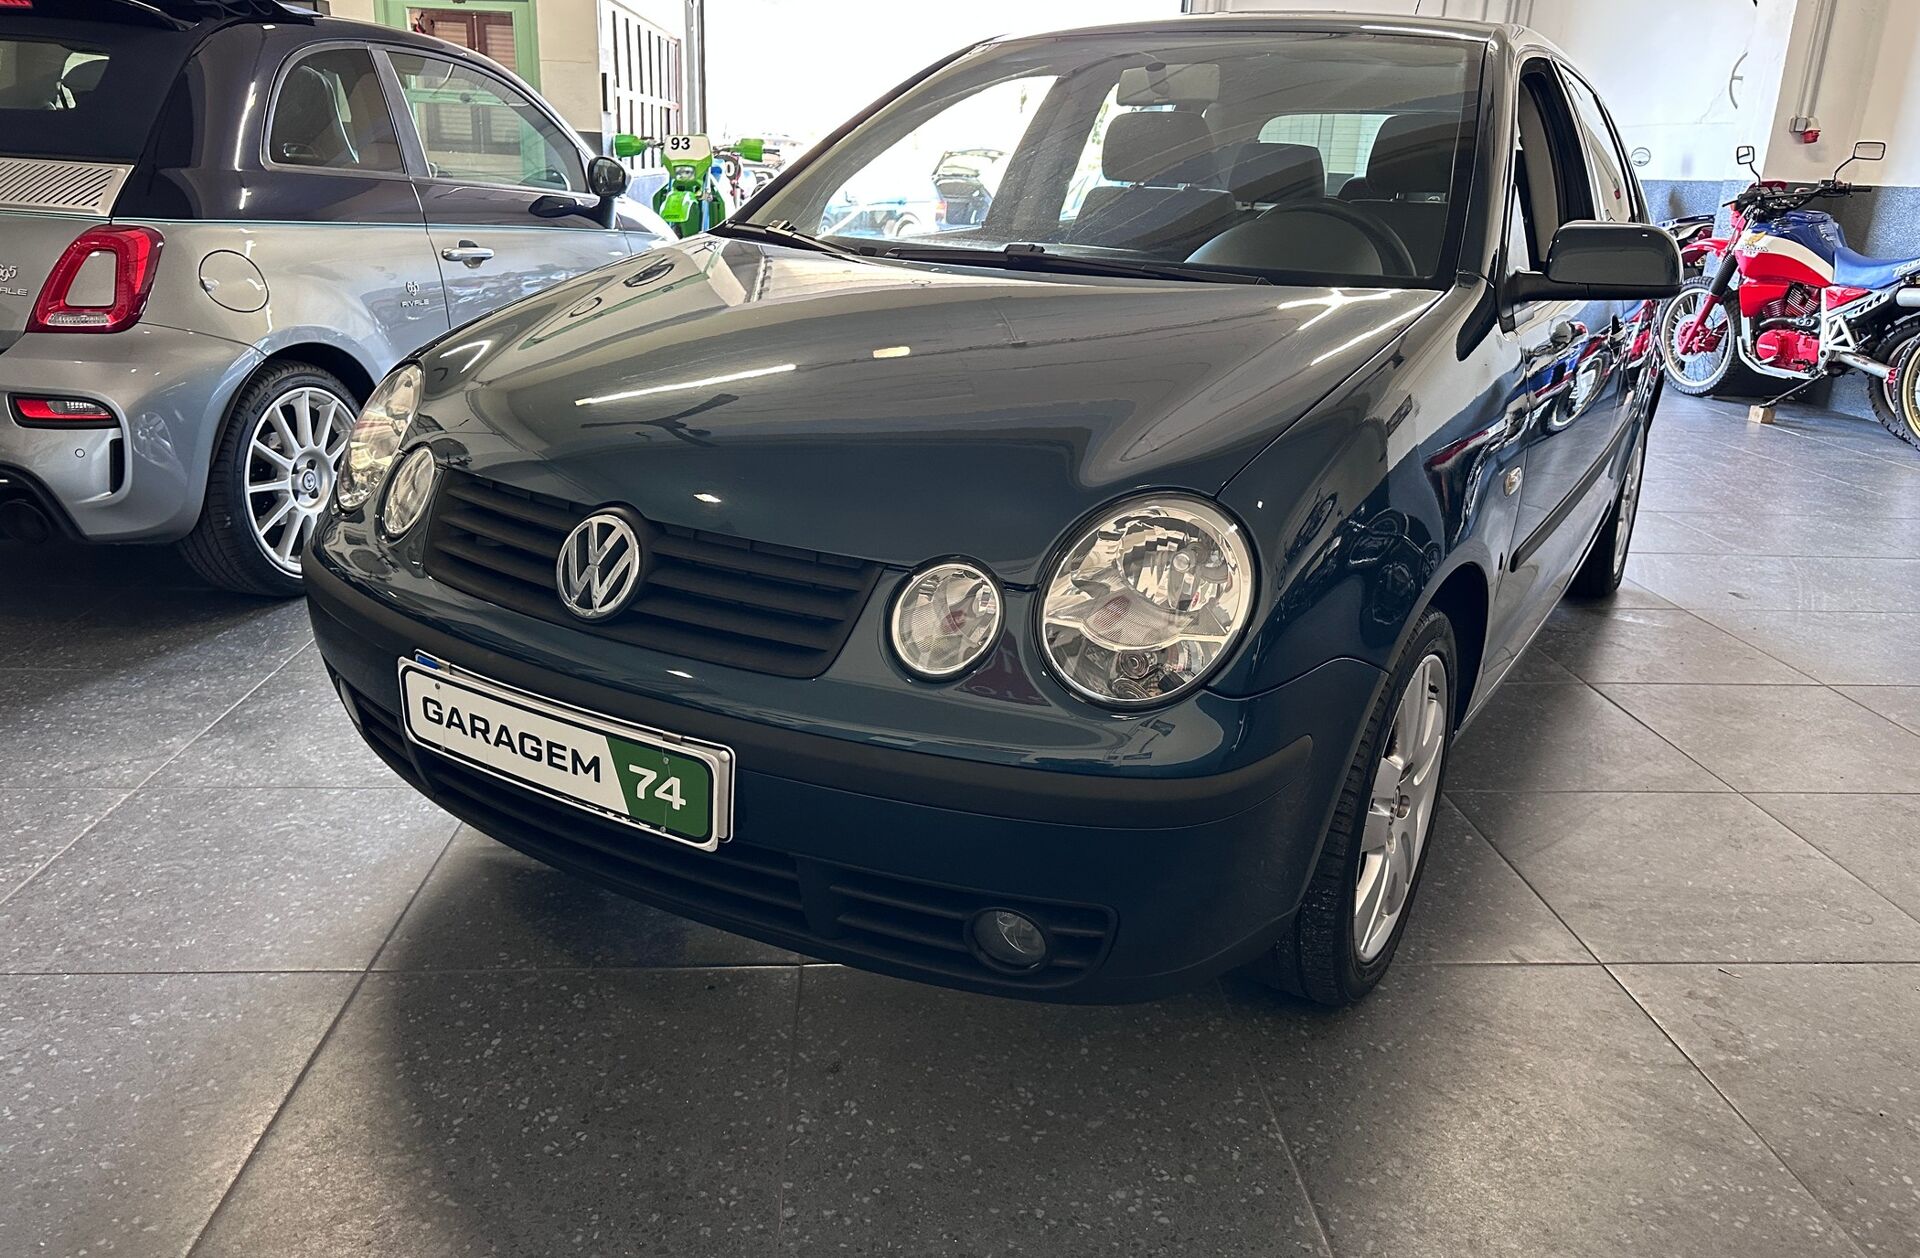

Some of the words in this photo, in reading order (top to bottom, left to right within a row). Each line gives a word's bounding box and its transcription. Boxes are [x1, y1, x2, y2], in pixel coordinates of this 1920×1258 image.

[671, 137, 690, 150] 93
[422, 696, 600, 783] GARAGEM
[628, 764, 686, 810] 74
